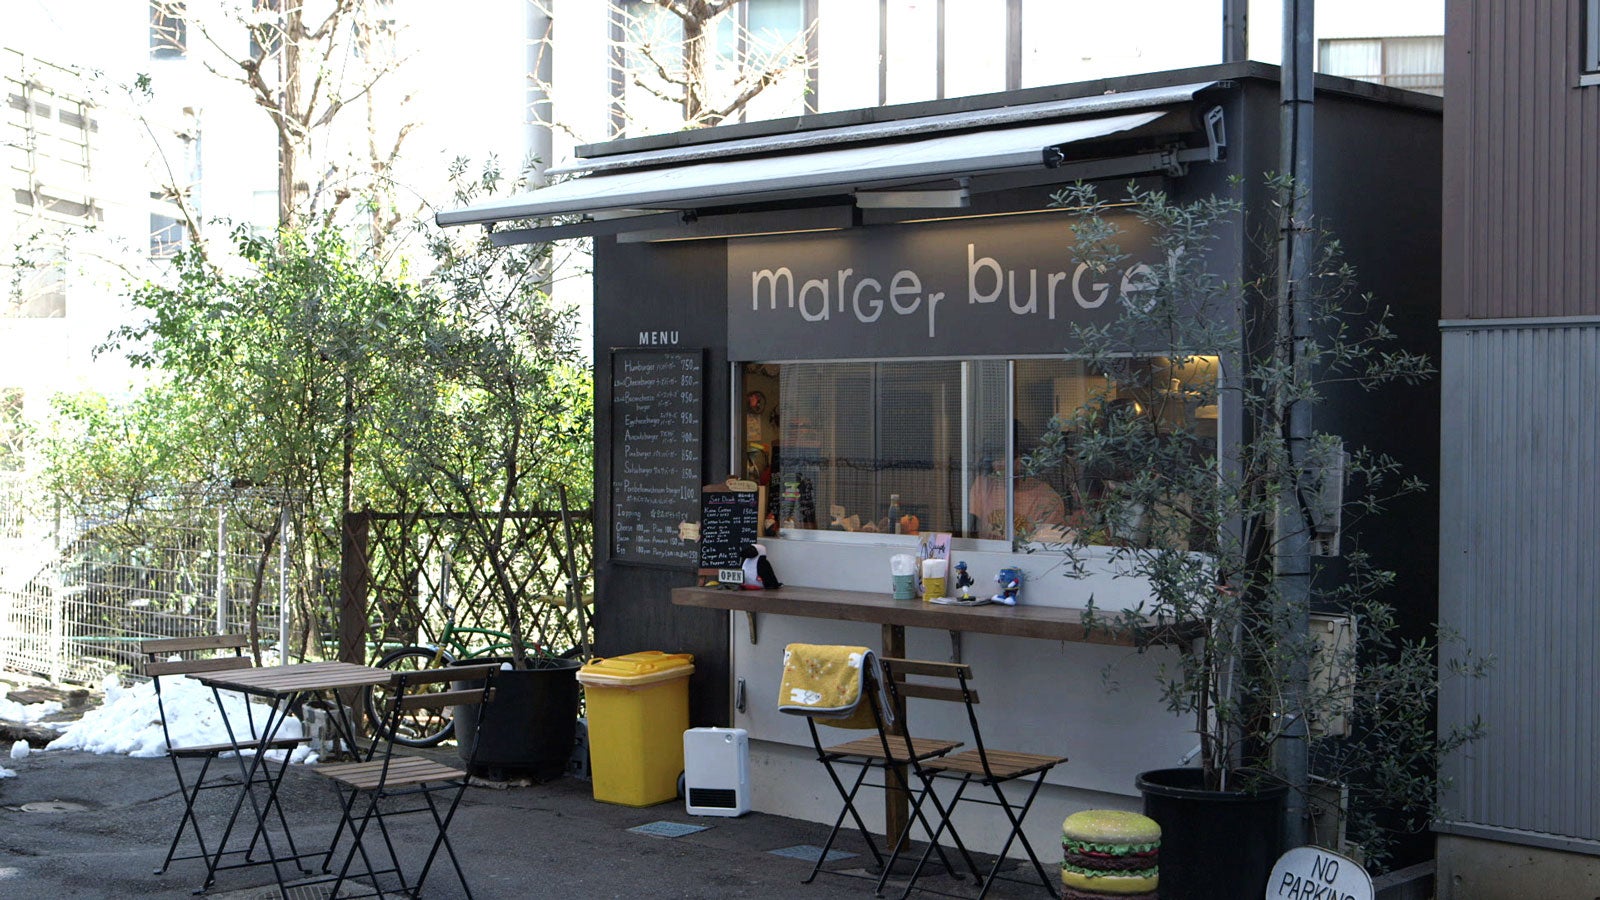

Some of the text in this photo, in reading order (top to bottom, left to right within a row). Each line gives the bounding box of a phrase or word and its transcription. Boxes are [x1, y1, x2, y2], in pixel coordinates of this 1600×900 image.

[639, 330, 679, 346] MENU
[616, 503, 641, 521] Topping
[701, 546, 717, 554] Cola
[720, 570, 743, 582] OPEN
[1311, 854, 1340, 885] NO
[1278, 871, 1356, 900] PARKI
